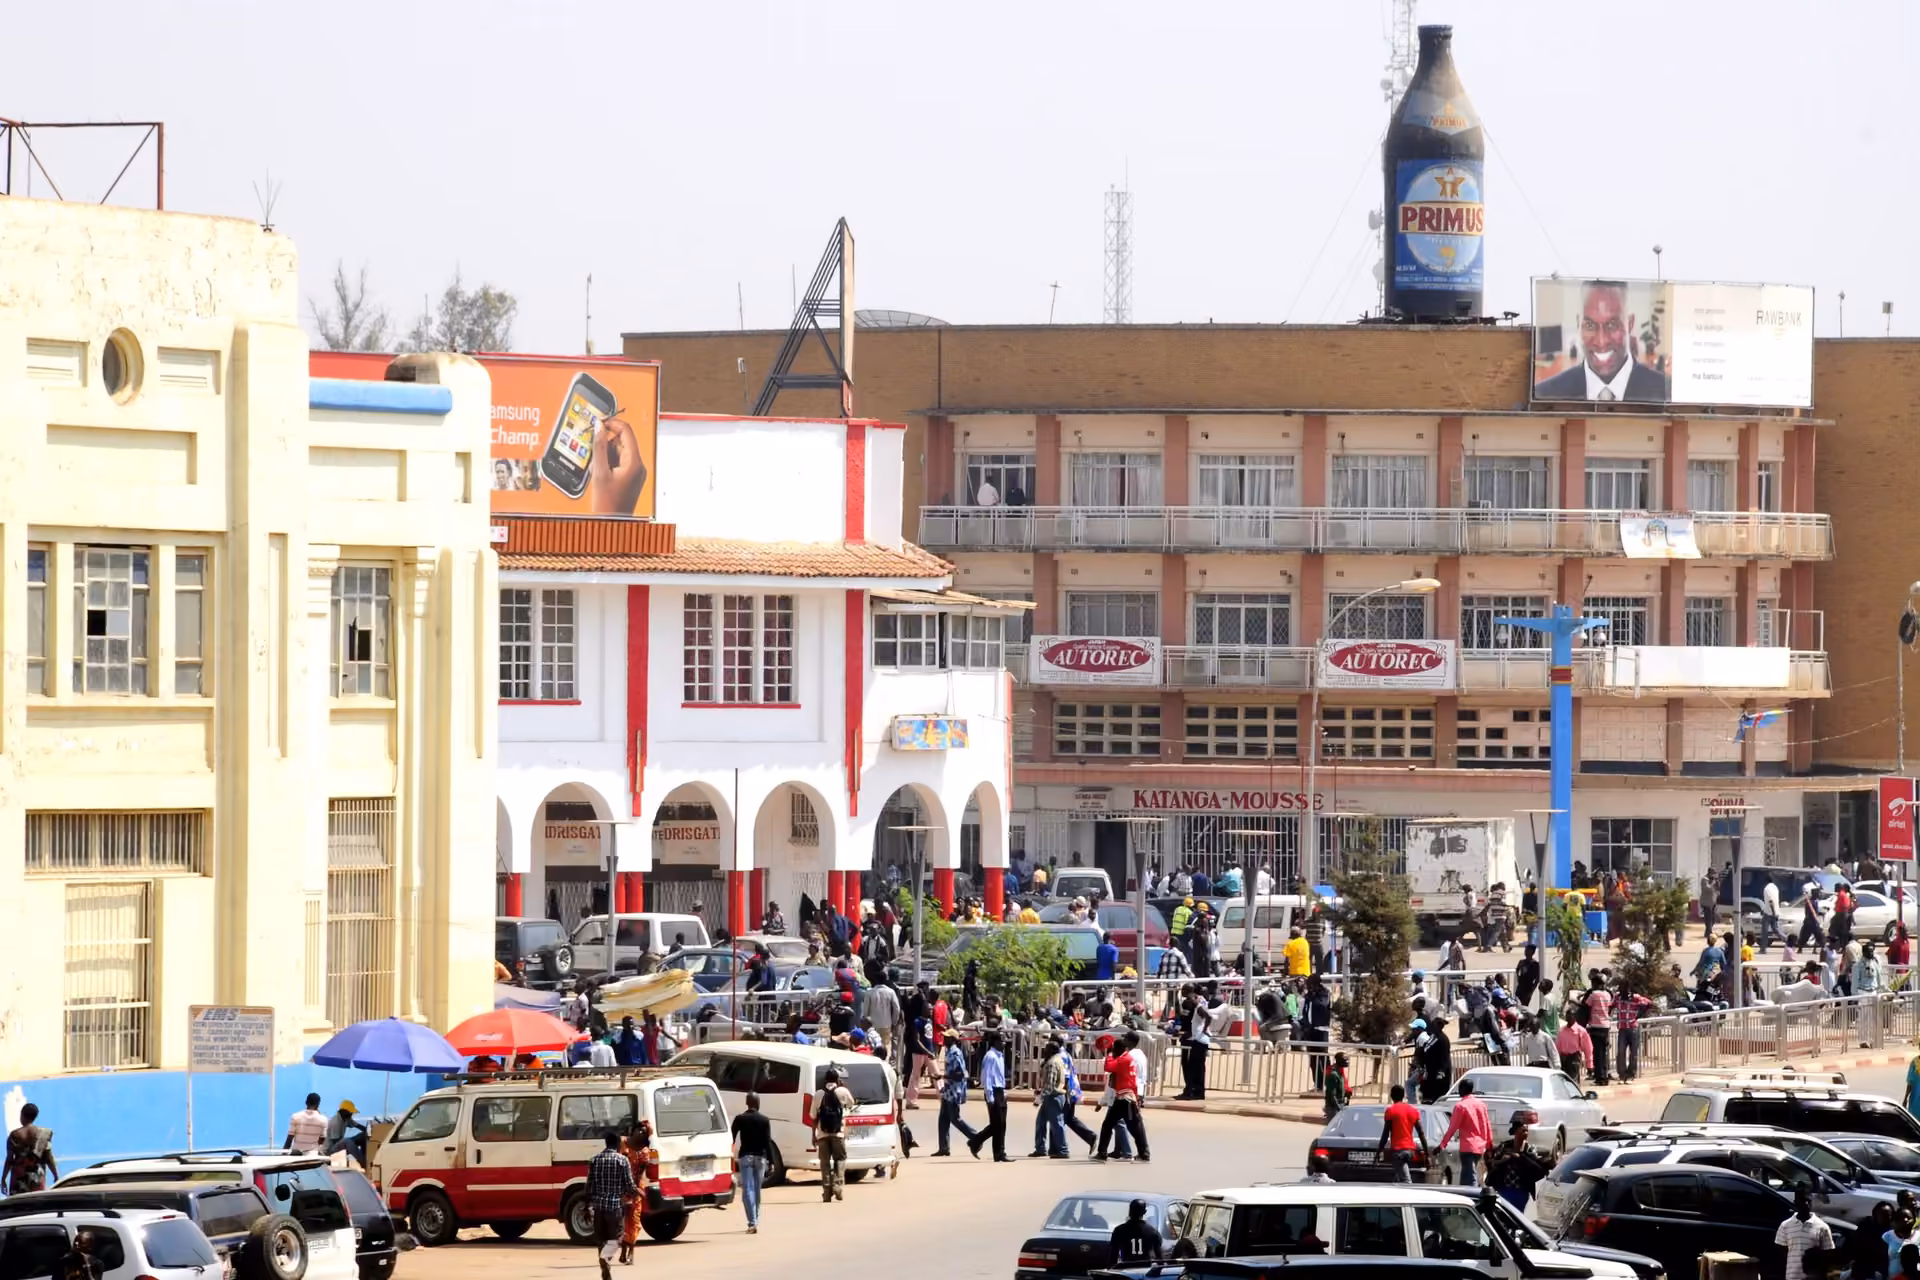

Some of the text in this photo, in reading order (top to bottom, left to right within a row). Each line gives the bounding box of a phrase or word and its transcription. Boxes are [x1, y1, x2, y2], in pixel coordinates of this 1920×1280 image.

[1401, 206, 1484, 232] PRIMUS
[1756, 310, 1802, 327] RAWBANK
[490, 405, 540, 426] amsung
[1053, 649, 1144, 667] AUTOREC
[1340, 653, 1436, 670] AUTOREC
[1133, 789, 1325, 811] KATANGA-MOUSSE
[664, 826, 721, 840] DRISGAT
[1130, 1238, 1144, 1255] 11
